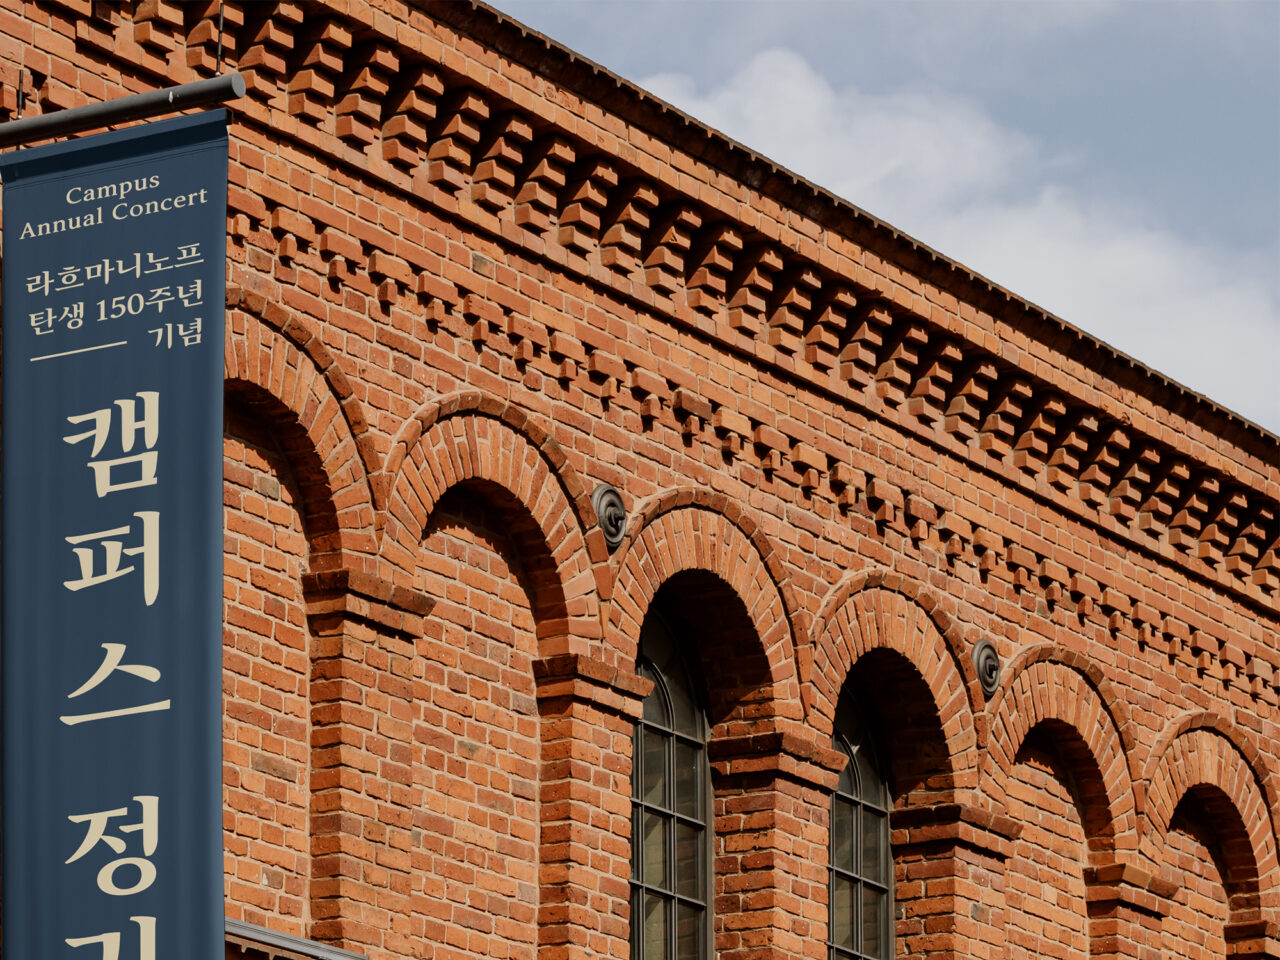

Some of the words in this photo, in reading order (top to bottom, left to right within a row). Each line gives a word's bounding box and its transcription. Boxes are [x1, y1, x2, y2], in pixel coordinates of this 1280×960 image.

[19, 207, 104, 240] Annual
[111, 187, 208, 221] Concert
[65, 174, 160, 205] Campus
[25, 242, 205, 297] 라흐마니노프
[27, 300, 86, 336] 탄생
[95, 279, 204, 322] 150주년
[147, 317, 203, 351] 기념
[58, 390, 172, 727] 캠퍼스
